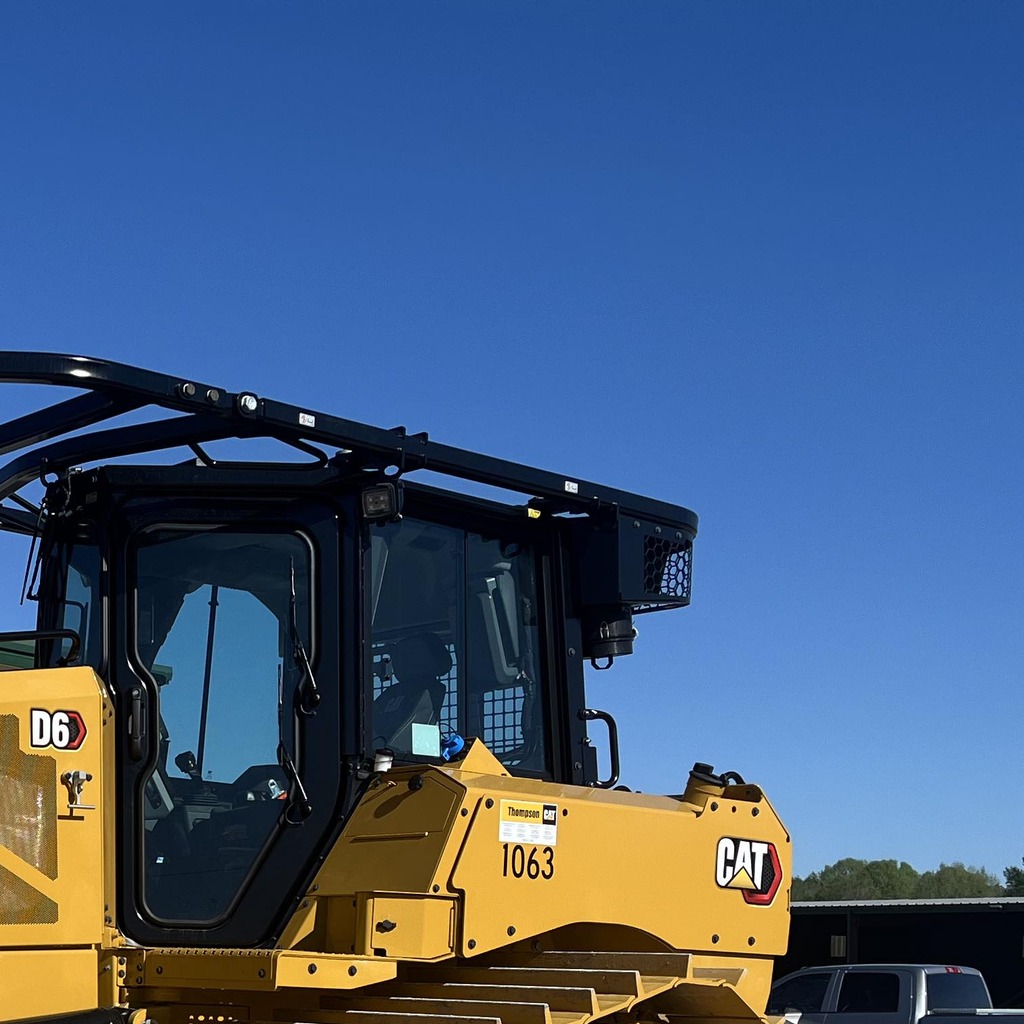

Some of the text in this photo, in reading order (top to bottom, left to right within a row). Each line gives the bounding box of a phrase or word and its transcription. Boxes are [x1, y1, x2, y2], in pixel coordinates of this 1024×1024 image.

[31, 709, 70, 748] D6
[508, 806, 556, 821] Thompson CAT
[502, 843, 554, 880] 1063
[716, 837, 769, 891] CAT
